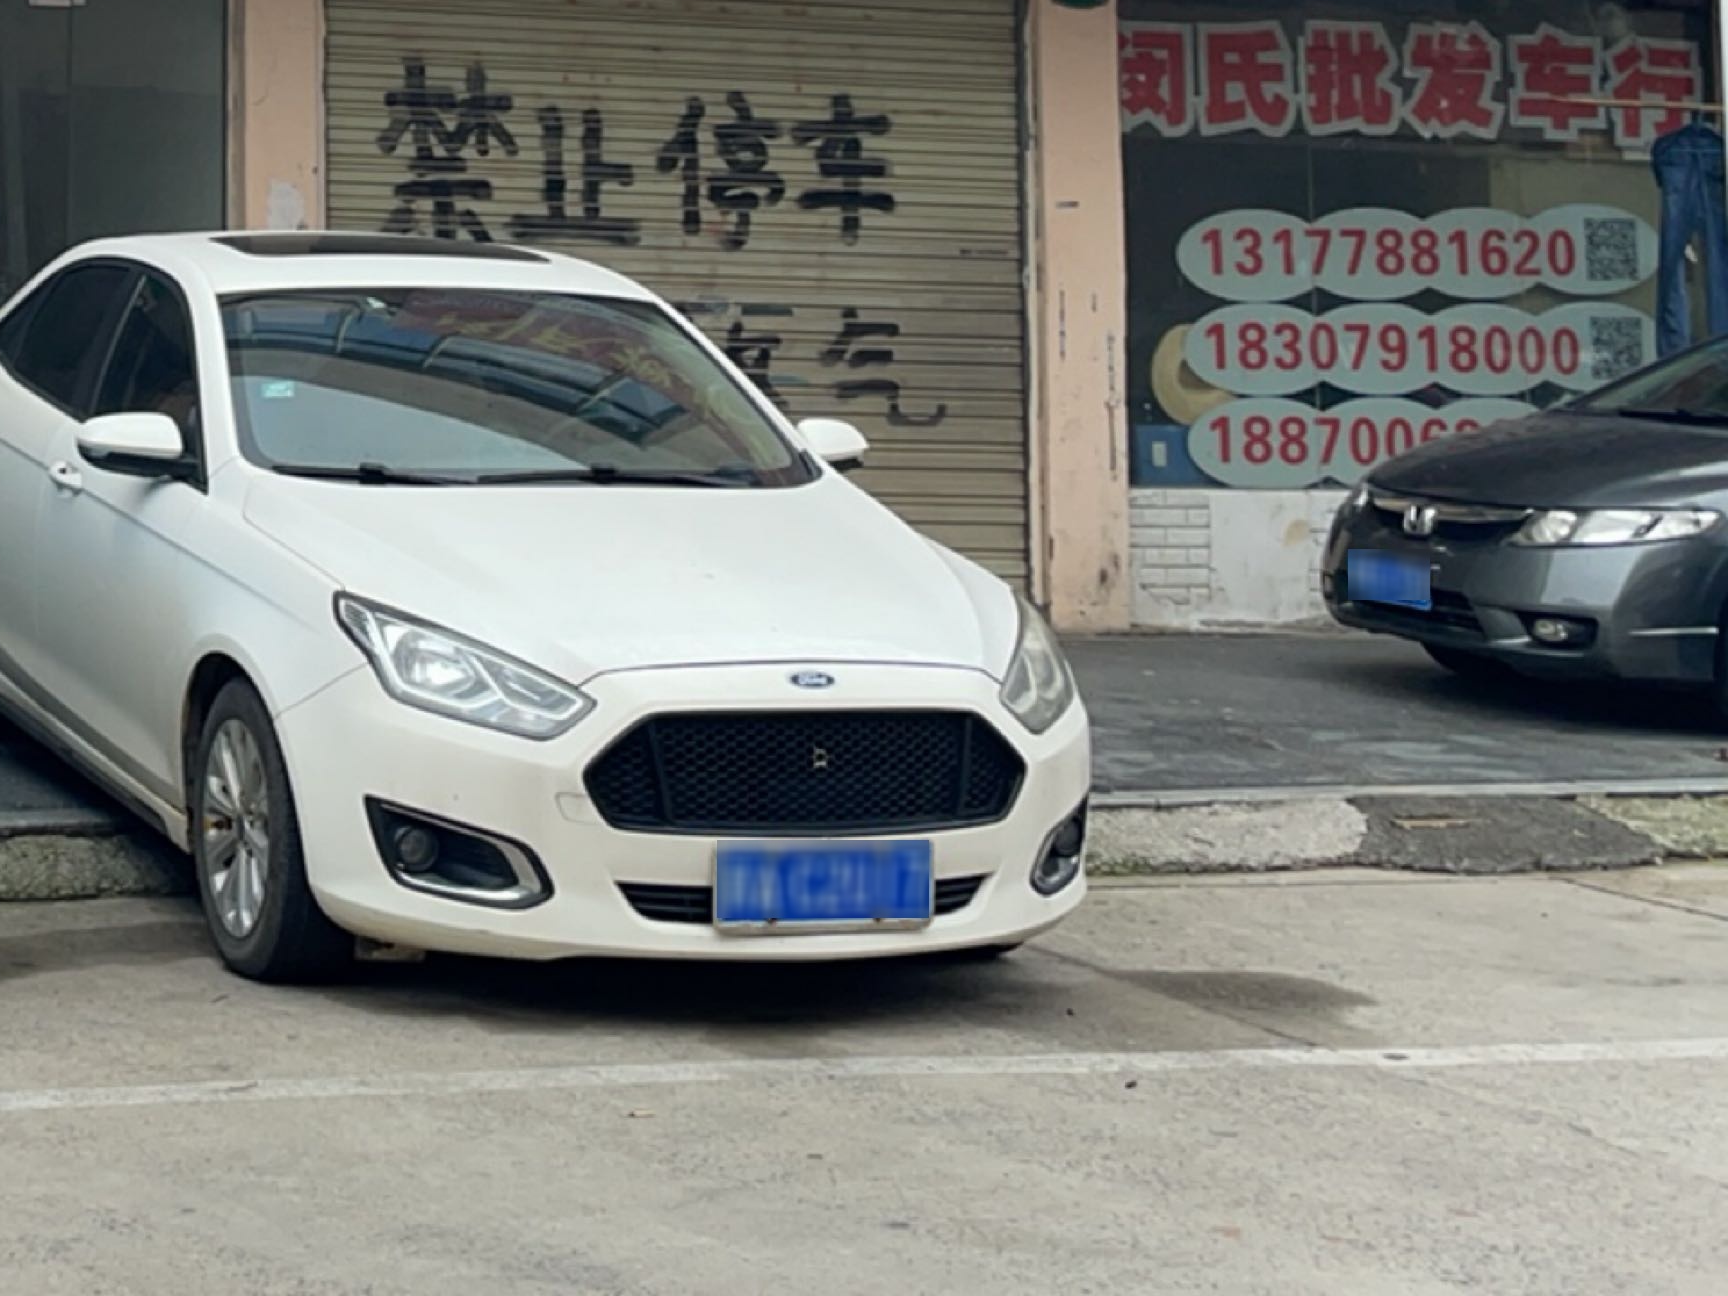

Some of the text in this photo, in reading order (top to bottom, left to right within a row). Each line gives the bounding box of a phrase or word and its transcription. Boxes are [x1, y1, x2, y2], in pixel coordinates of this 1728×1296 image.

[1117, 24, 1699, 144] 闵氏批发车行
[376, 56, 897, 249] 禁止停车
[1200, 226, 1577, 277] 13177881620
[1204, 322, 1581, 376] 18307918000
[1208, 415, 1482, 466] 188700
